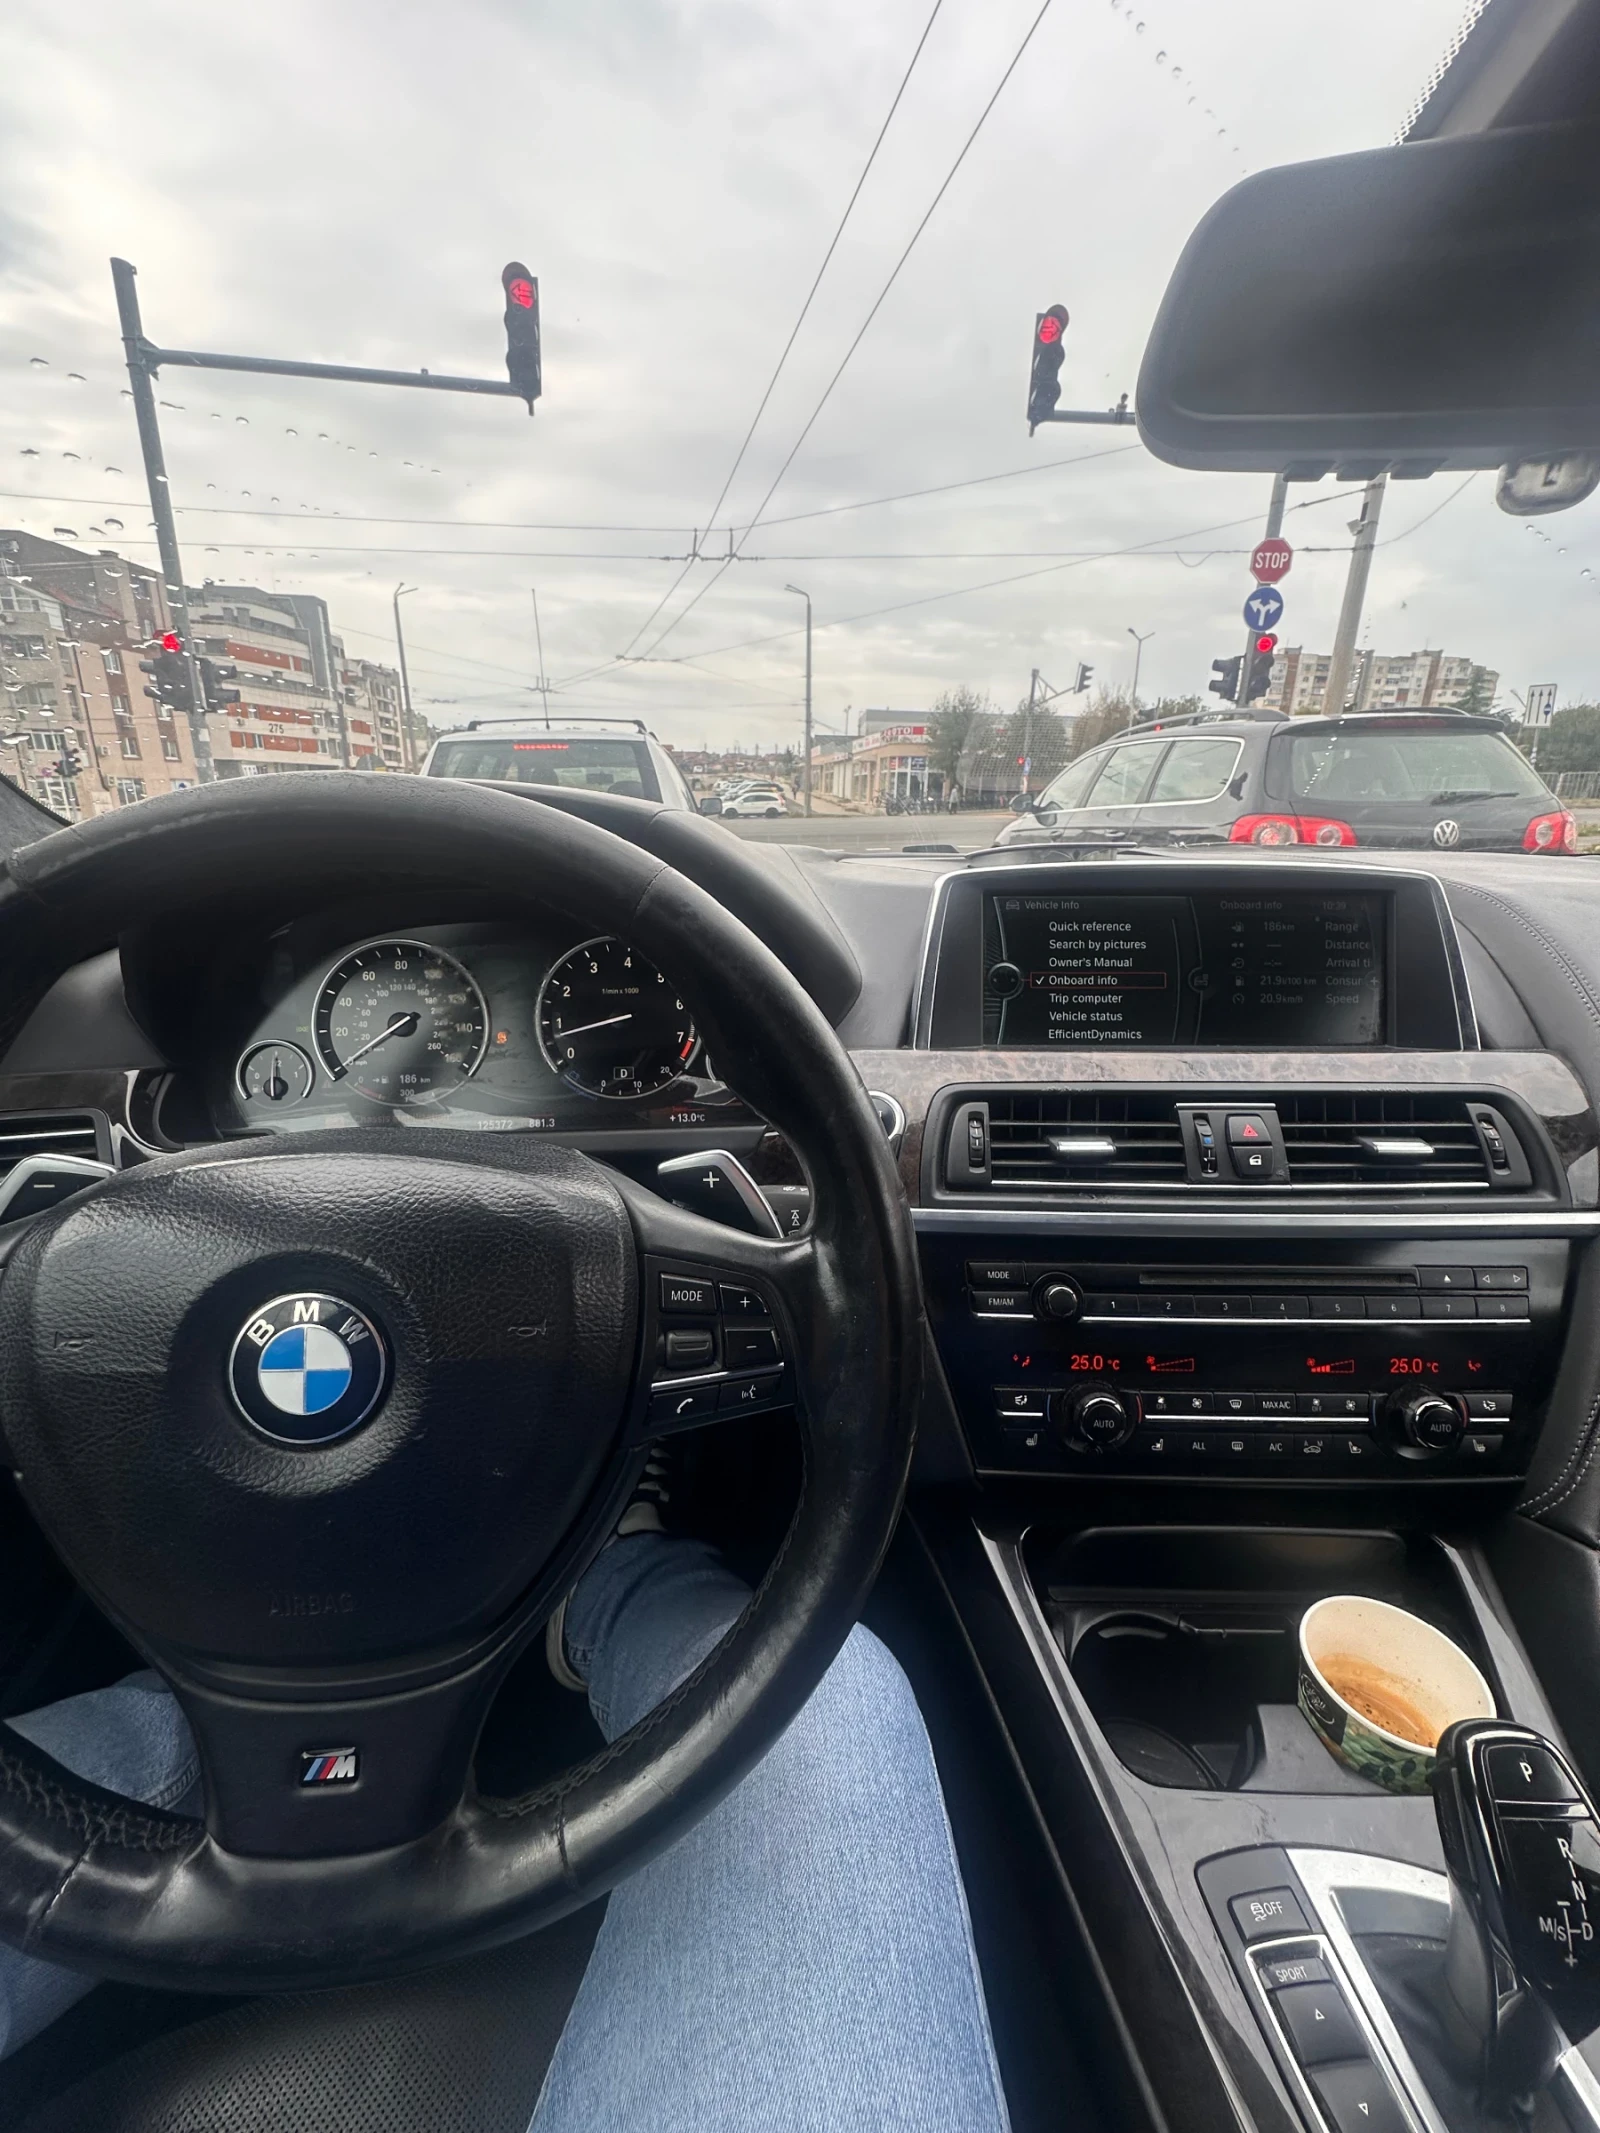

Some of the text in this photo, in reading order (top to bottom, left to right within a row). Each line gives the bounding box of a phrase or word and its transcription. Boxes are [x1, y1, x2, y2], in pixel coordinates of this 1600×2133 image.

[1255, 552, 1290, 569] STOP
[268, 722, 285, 734] 275
[1024, 900, 1080, 910] Vehicle Info
[1220, 899, 1262, 910] Onboard
[1049, 921, 1132, 932] Quick reference
[1325, 921, 1359, 933] Range
[1049, 939, 1147, 951] Search by pictures
[394, 960, 408, 970] 80
[624, 956, 632, 968] 4
[1049, 957, 1133, 968] Owner's Manual
[1325, 957, 1360, 968] Arrival
[590, 962, 598, 974] 3
[362, 971, 376, 981] 60
[657, 973, 665, 983] 5
[1049, 975, 1118, 985] Onboard info
[563, 985, 571, 997] 2
[339, 997, 352, 1007] 40
[676, 999, 684, 1010] 6
[1049, 993, 1123, 1005] Trip computer
[1325, 993, 1359, 1007] Speed
[361, 1009, 371, 1017] 60
[1049, 1011, 1123, 1021] Vehicle status
[358, 1020, 368, 1028] 40
[556, 1017, 562, 1029] 1
[335, 1026, 349, 1037] 20
[360, 1033, 371, 1041] 20
[677, 1031, 685, 1043] 7
[1048, 1029, 1143, 1041] EfficientDynamics
[427, 1042, 442, 1050] 260
[567, 1047, 575, 1060] 0
[620, 1069, 628, 1078] D
[660, 1066, 670, 1074] 20
[399, 1074, 417, 1084] 186
[633, 1080, 643, 1088] 10
[477, 1118, 513, 1130] 125372
[528, 1117, 556, 1129] 881.3
[987, 1270, 1010, 1280] MODE
[671, 1290, 703, 1302] MODE
[988, 1297, 1015, 1307] FM/AM
[1111, 1301, 1116, 1309] 1
[1166, 1302, 1172, 1310] 2
[1222, 1302, 1228, 1311] 3
[1279, 1303, 1285, 1311] 4
[1335, 1303, 1341, 1312] 5
[1391, 1304, 1397, 1312] 6
[1446, 1304, 1451, 1312] 7
[1500, 1304, 1506, 1312] 8
[246, 1300, 370, 1347] BMW
[1070, 1355, 1104, 1371] 25.0
[1390, 1357, 1423, 1374] 25.0
[1263, 1400, 1291, 1409] MAX A/C
[1093, 1420, 1115, 1429] AUTO
[1430, 1423, 1452, 1433] AUTO
[1192, 1441, 1206, 1450] ALL
[1269, 1442, 1283, 1452] A/C
[268, 1592, 354, 1617] AIRBAG
[1519, 1762, 1533, 1782] P
[1557, 1837, 1574, 1859] R
[1571, 1880, 1587, 1901] N
[1263, 1901, 1283, 1916] OFF
[1538, 1916, 1568, 1942] M/S
[1581, 1922, 1594, 1941] D
[1275, 1965, 1308, 1983] SPORT
